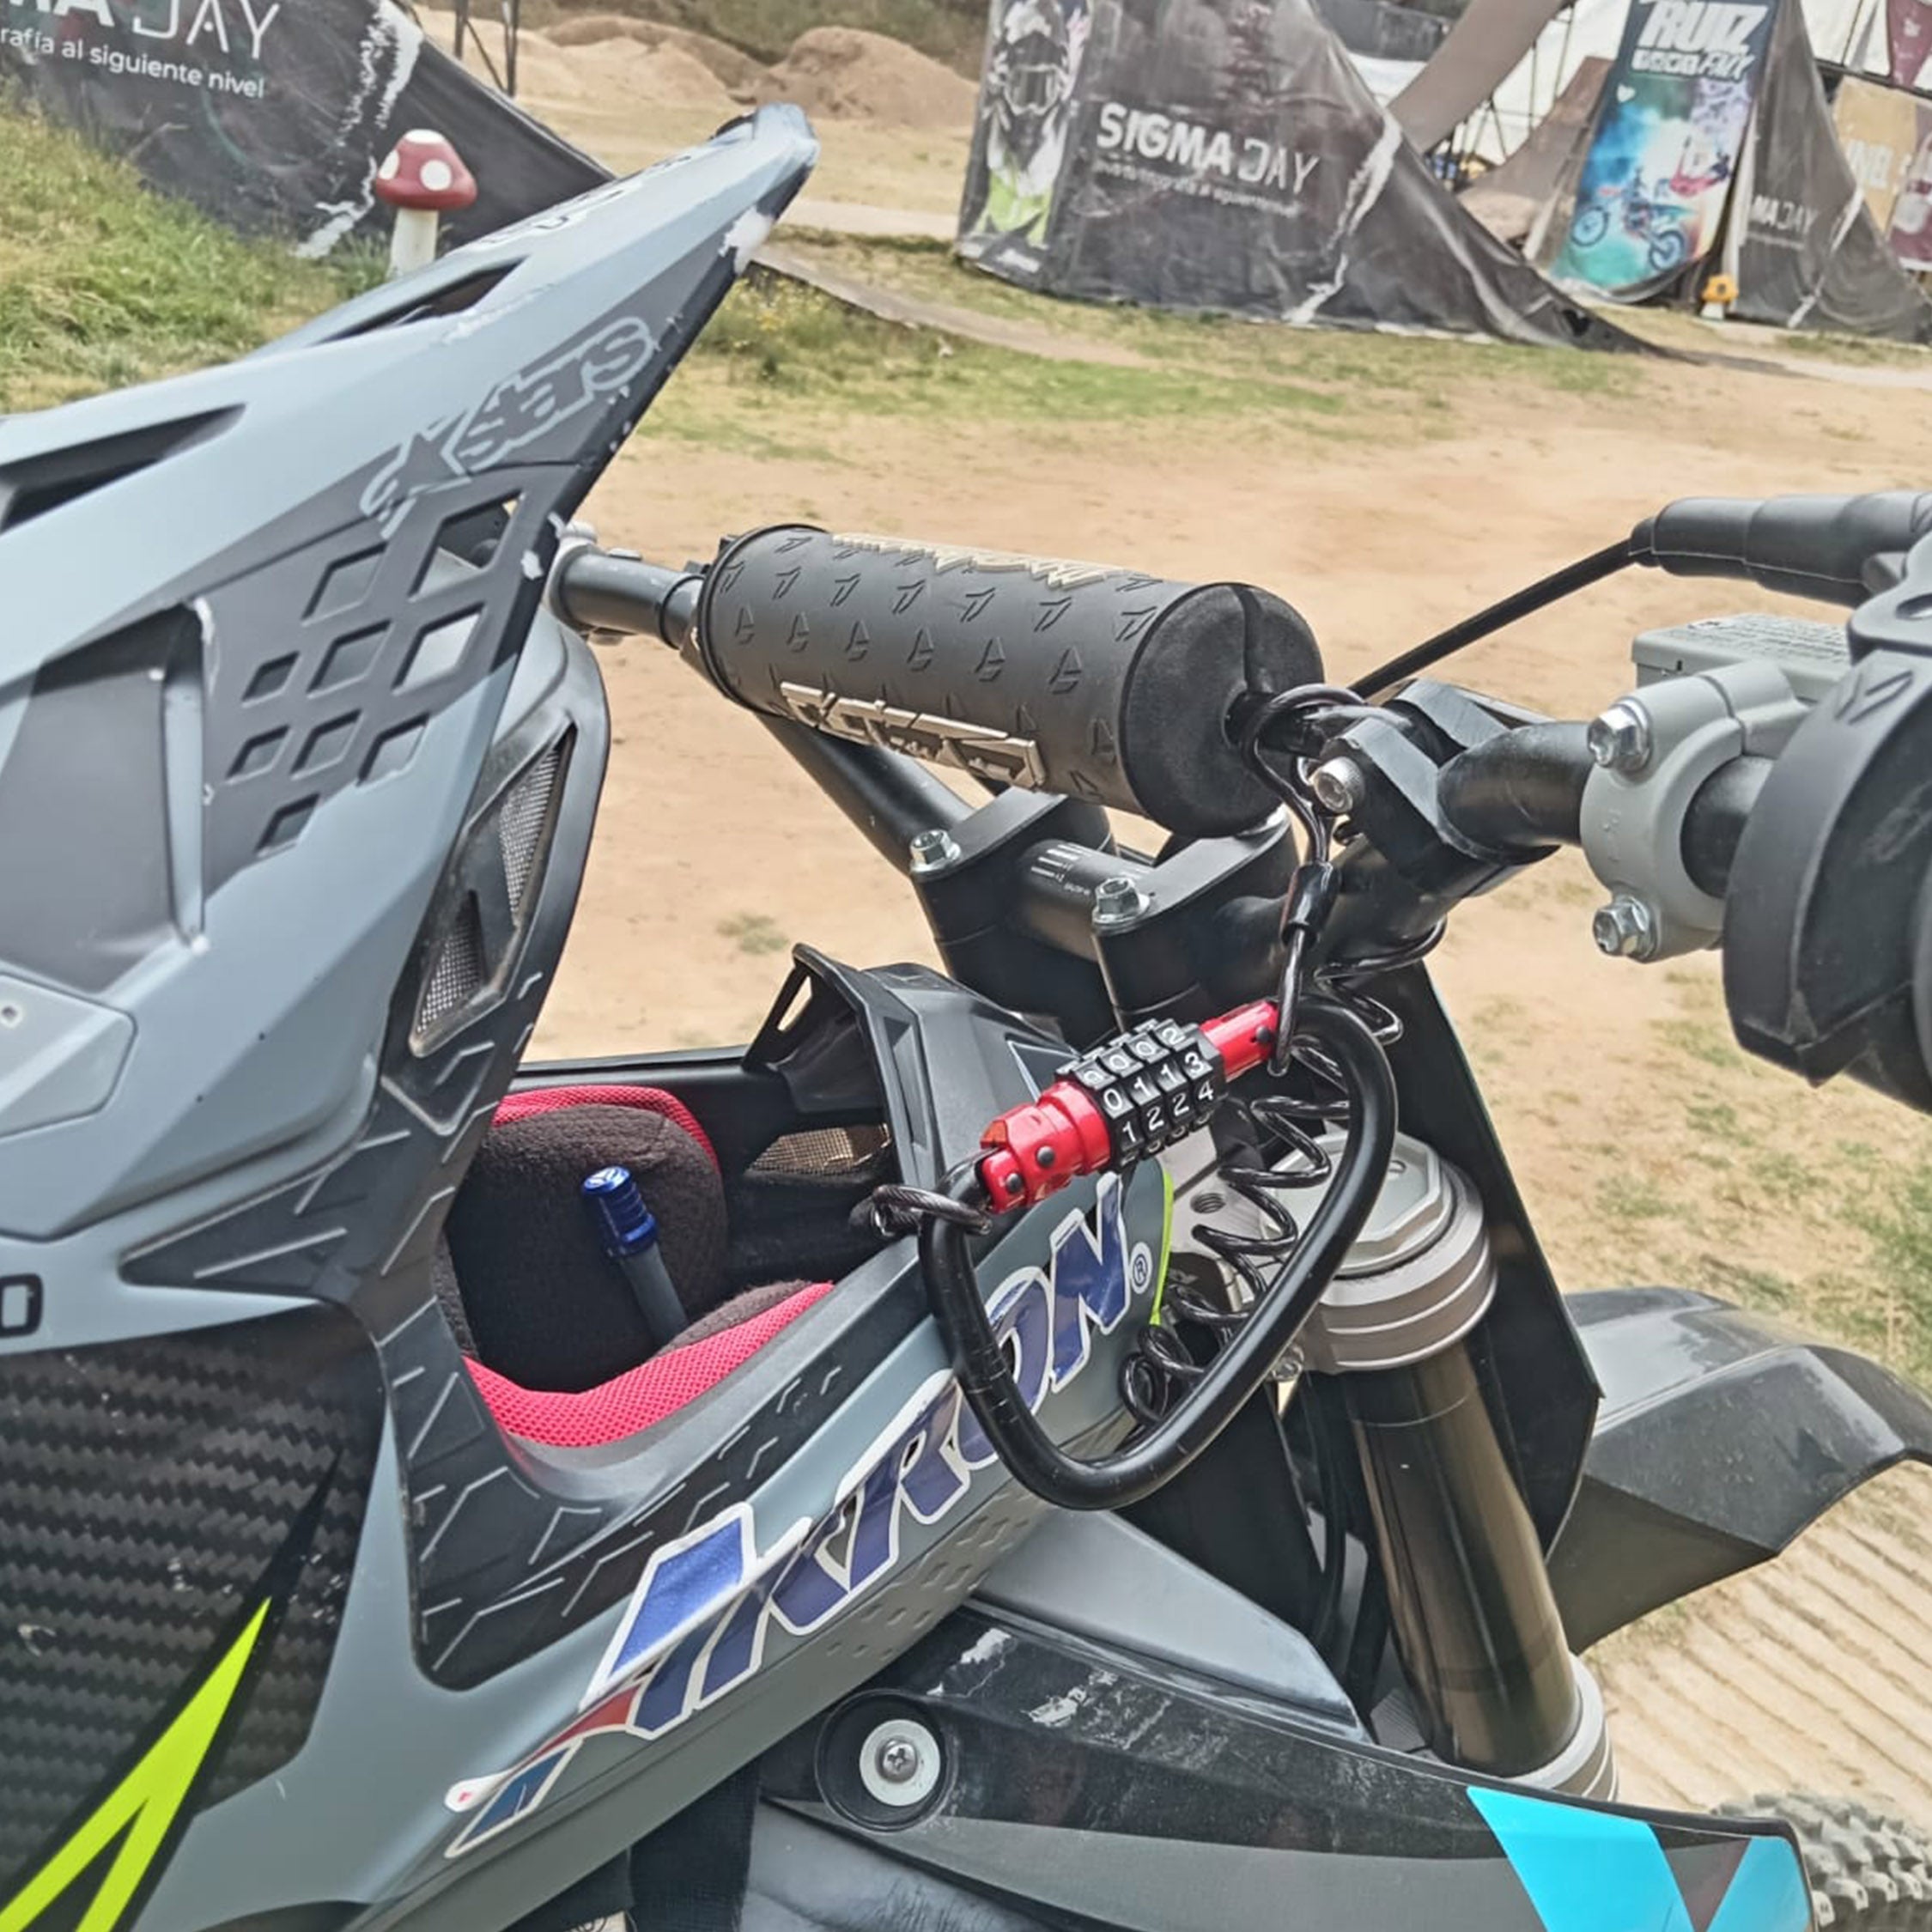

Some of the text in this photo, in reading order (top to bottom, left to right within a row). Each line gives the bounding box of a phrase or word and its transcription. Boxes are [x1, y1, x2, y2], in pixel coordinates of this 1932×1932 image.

[61, 39, 83, 60] al
[89, 44, 203, 86] siguiente
[209, 73, 265, 98] nivel
[1097, 102, 1232, 176] SIGMA
